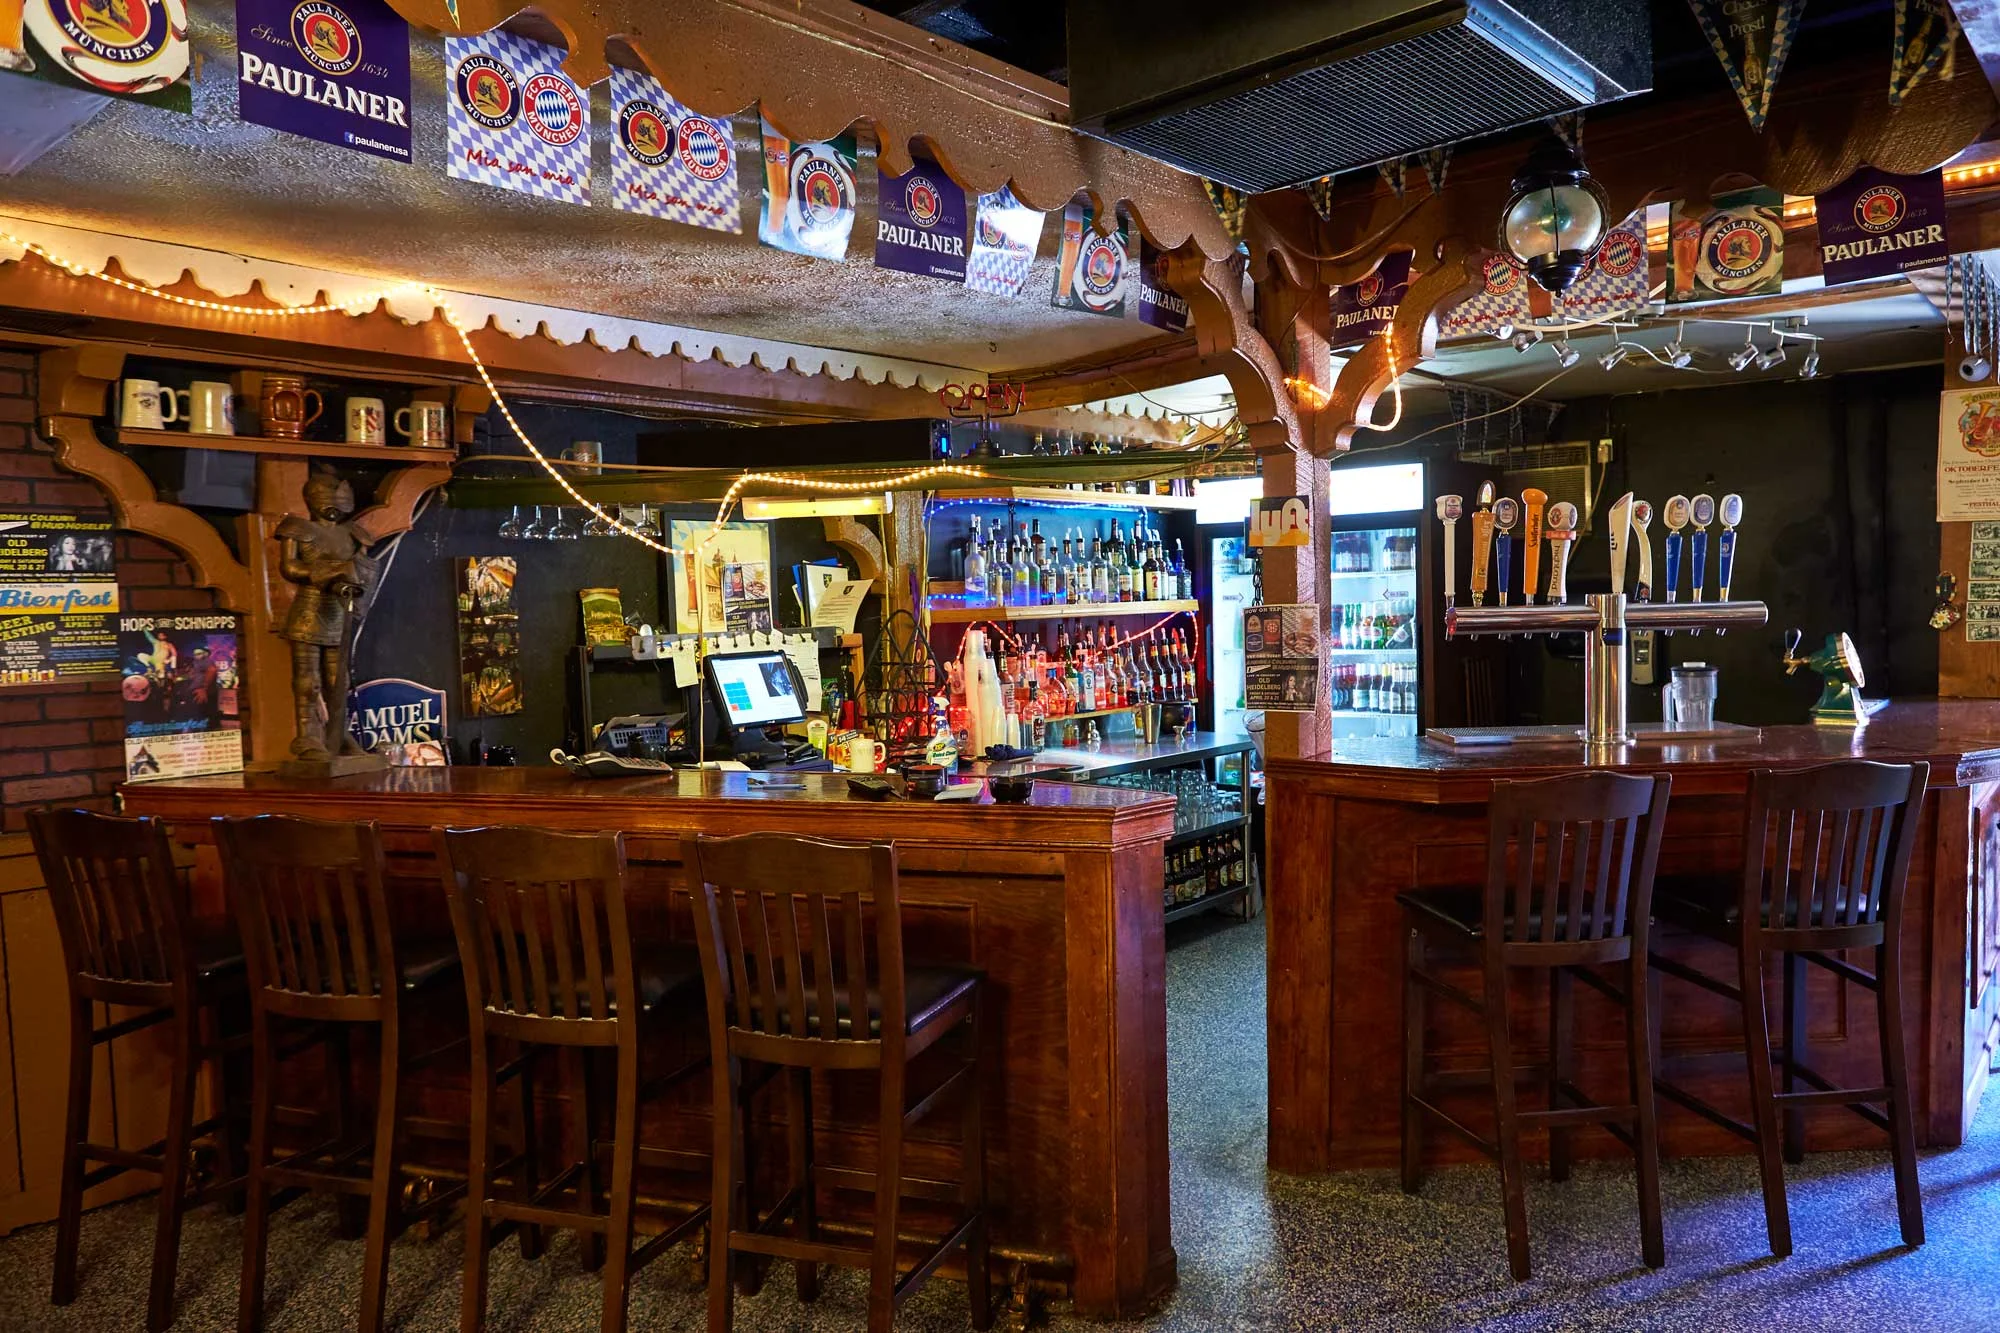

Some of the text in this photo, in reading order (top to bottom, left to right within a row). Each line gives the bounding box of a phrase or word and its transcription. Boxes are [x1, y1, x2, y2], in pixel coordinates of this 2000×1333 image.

[296, 3, 356, 39] PAULANER
[1729, 15, 1766, 38] Prost!
[62, 19, 155, 62] MÜNCHEN
[250, 23, 390, 79] Since 1634
[302, 45, 353, 72] MÜNCHEN
[459, 57, 517, 92] PAULANER
[239, 50, 409, 128] PAULANER
[526, 77, 579, 112] FC BAYERN
[465, 102, 513, 127] MÜNCHEN
[527, 111, 580, 143] MÜNCHEN
[622, 102, 672, 132] PAULANER
[354, 135, 408, 157] paulanerusa
[680, 120, 726, 150] FC BAYERN
[626, 142, 668, 164] MÜNCHEN
[682, 150, 726, 178] MÜNCHEN
[466, 148, 575, 186] Mia san mia
[800, 160, 844, 192] PAULANER
[908, 178, 940, 200] PAULANER
[1858, 188, 1901, 209] PAULANER
[877, 220, 965, 257] PAULANER
[1610, 234, 1640, 248] BAYERN
[1712, 220, 1770, 246] PAULANER
[1822, 224, 1944, 264] PAULANER
[1086, 238, 1121, 262] PAULANER
[1904, 256, 1947, 268] paulanerusa
[1602, 256, 1639, 275] MÜNCHEN
[1715, 258, 1764, 278] MÜNCHEN
[1140, 284, 1190, 316] PAULANER
[940, 382, 1026, 410] OPEN
[1944, 465, 2000, 473] OKTOBERFE
[1250, 498, 1309, 546] lyft
[0, 548, 48, 556] IDELBERG
[8, 539, 28, 547] OLD
[0, 589, 112, 612] Bierfest
[0, 616, 32, 631] EER
[120, 617, 155, 632] HOPS
[347, 698, 440, 732] AMUEL
[362, 724, 433, 751] DAMS
